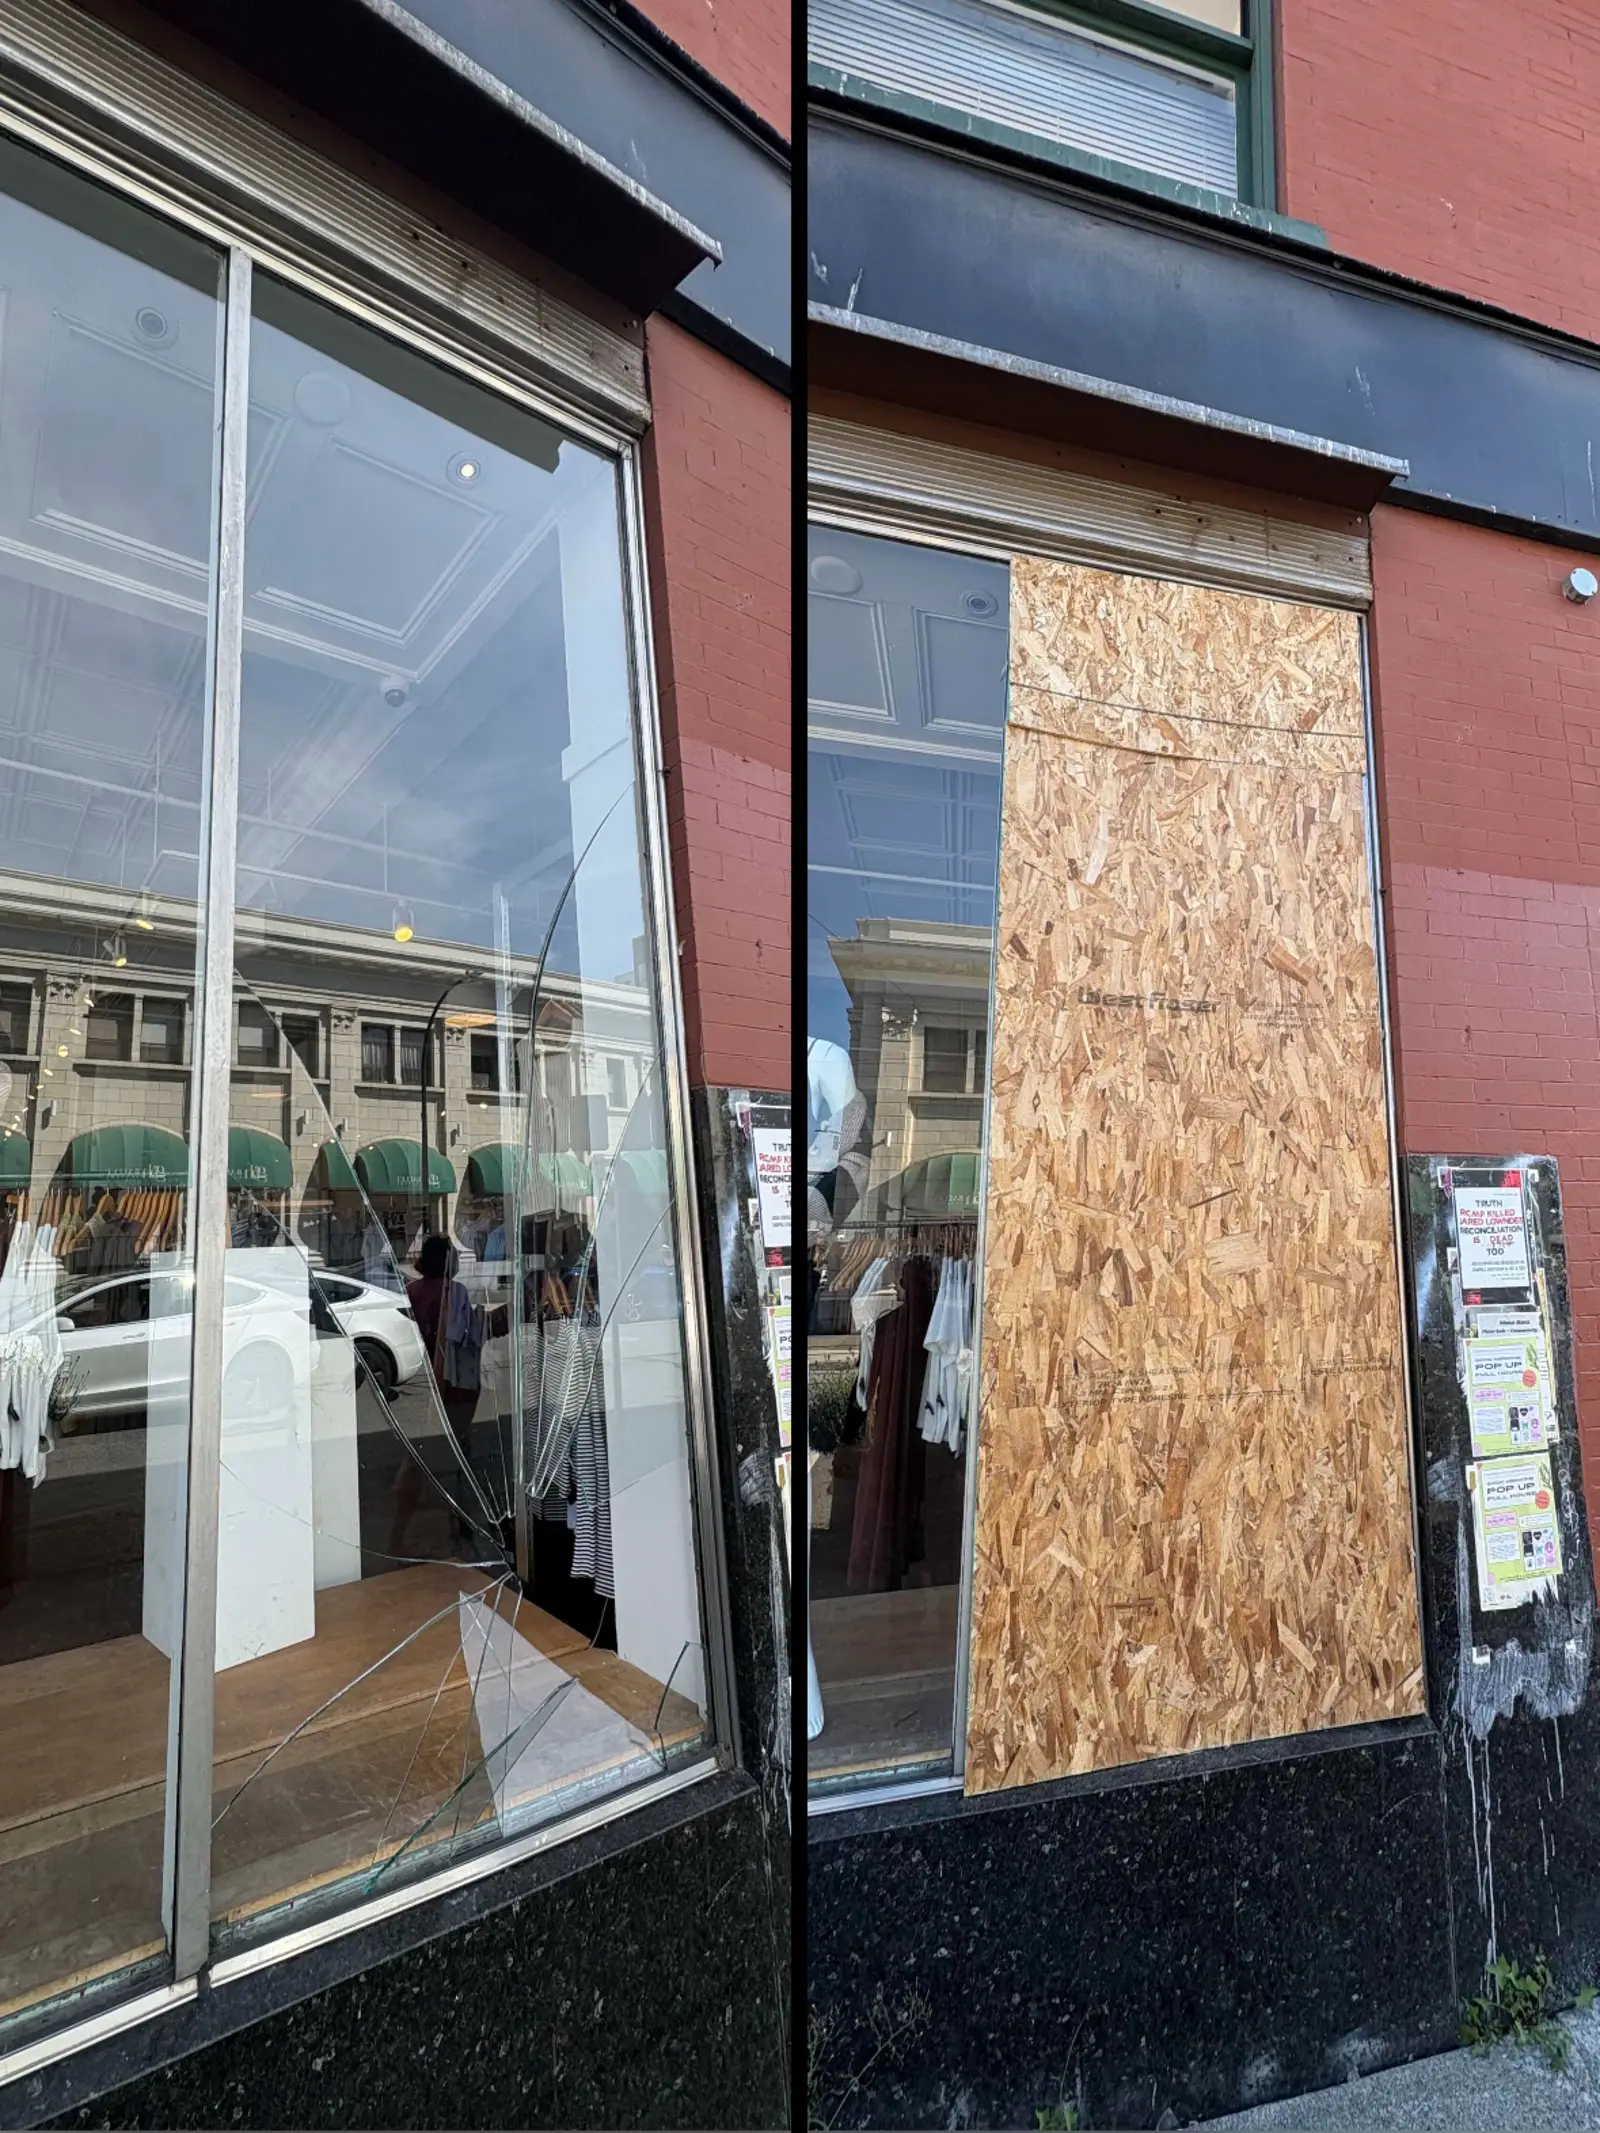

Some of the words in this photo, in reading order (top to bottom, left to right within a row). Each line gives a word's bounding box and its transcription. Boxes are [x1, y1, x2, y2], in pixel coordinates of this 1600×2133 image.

[1475, 1199, 1503, 1208] TRUTH
[1460, 1208, 1485, 1217] RCMP
[1487, 1208, 1515, 1217] KILLED
[1460, 1217, 1483, 1225] JARED
[1460, 1225, 1522, 1235] RECONCILIATION
[1486, 1247, 1504, 1256] TOO
[1475, 1362, 1502, 1371] POP
[1505, 1361, 1522, 1369] UP
[1487, 1485, 1514, 1494] POP
[1518, 1482, 1535, 1491] UP
